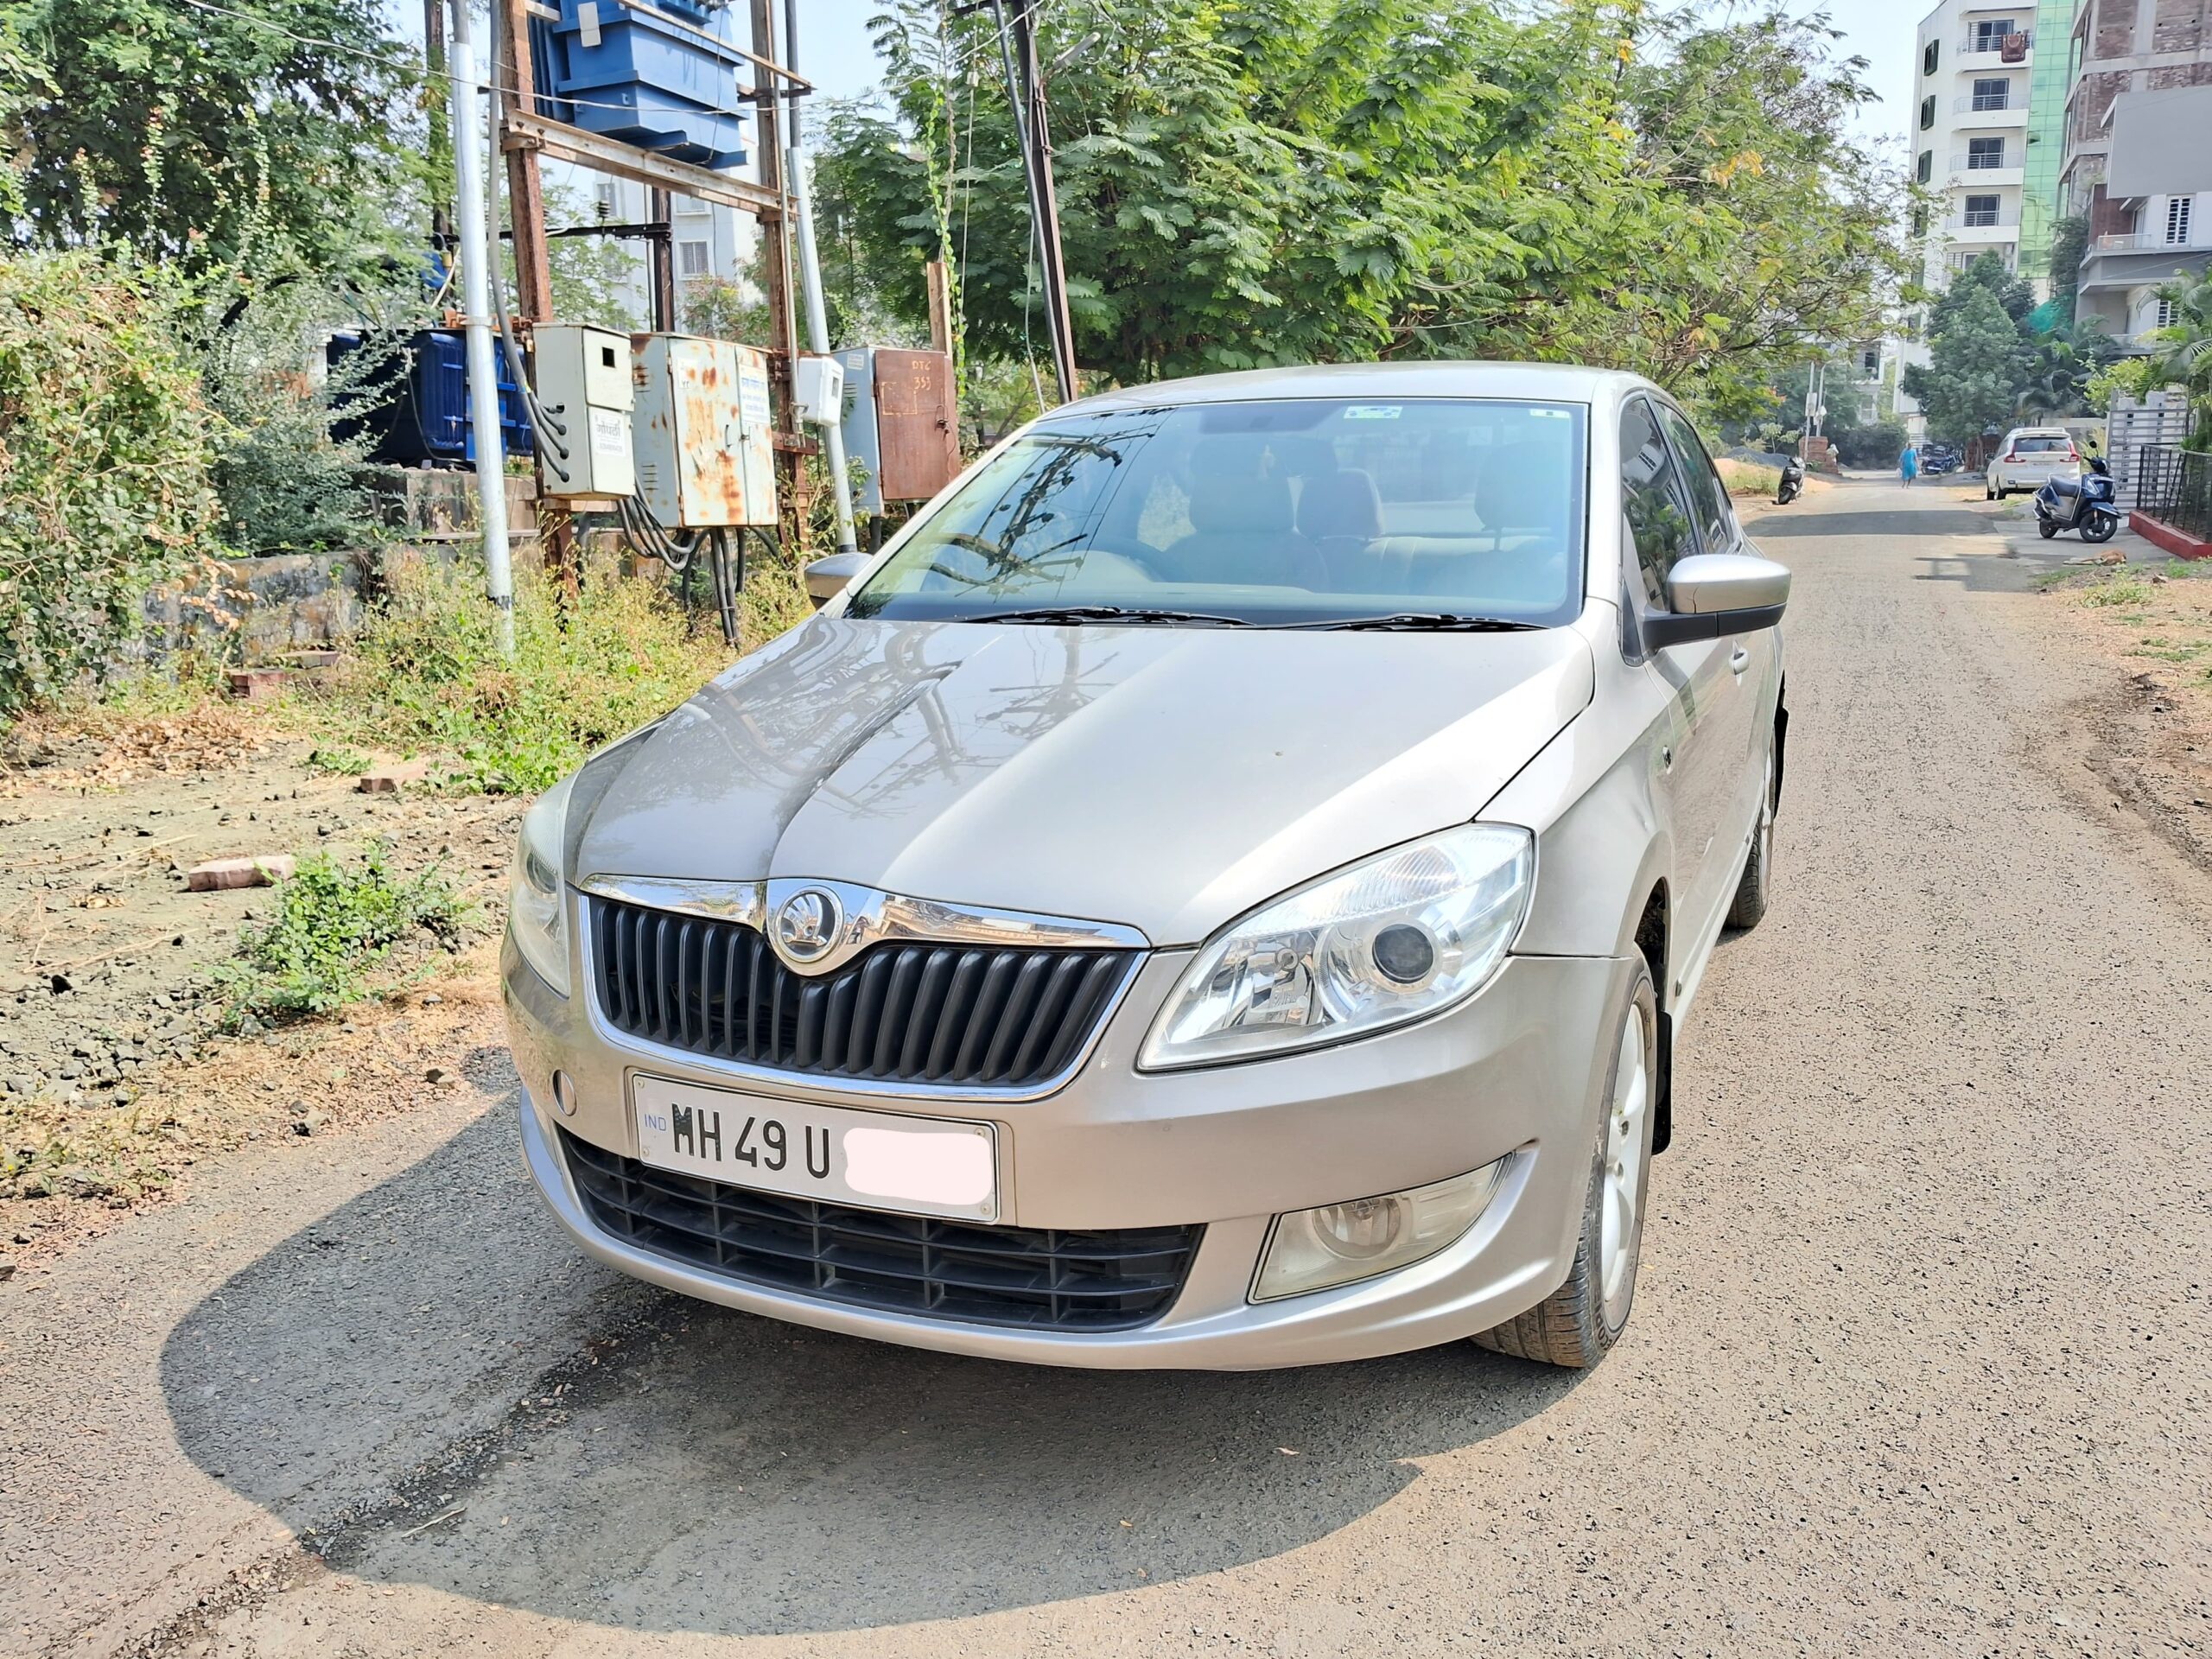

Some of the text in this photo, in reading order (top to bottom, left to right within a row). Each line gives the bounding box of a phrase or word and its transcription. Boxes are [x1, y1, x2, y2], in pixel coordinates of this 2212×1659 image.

[645, 1114, 667, 1131] IND
[671, 1103, 830, 1179] MH 49 U
